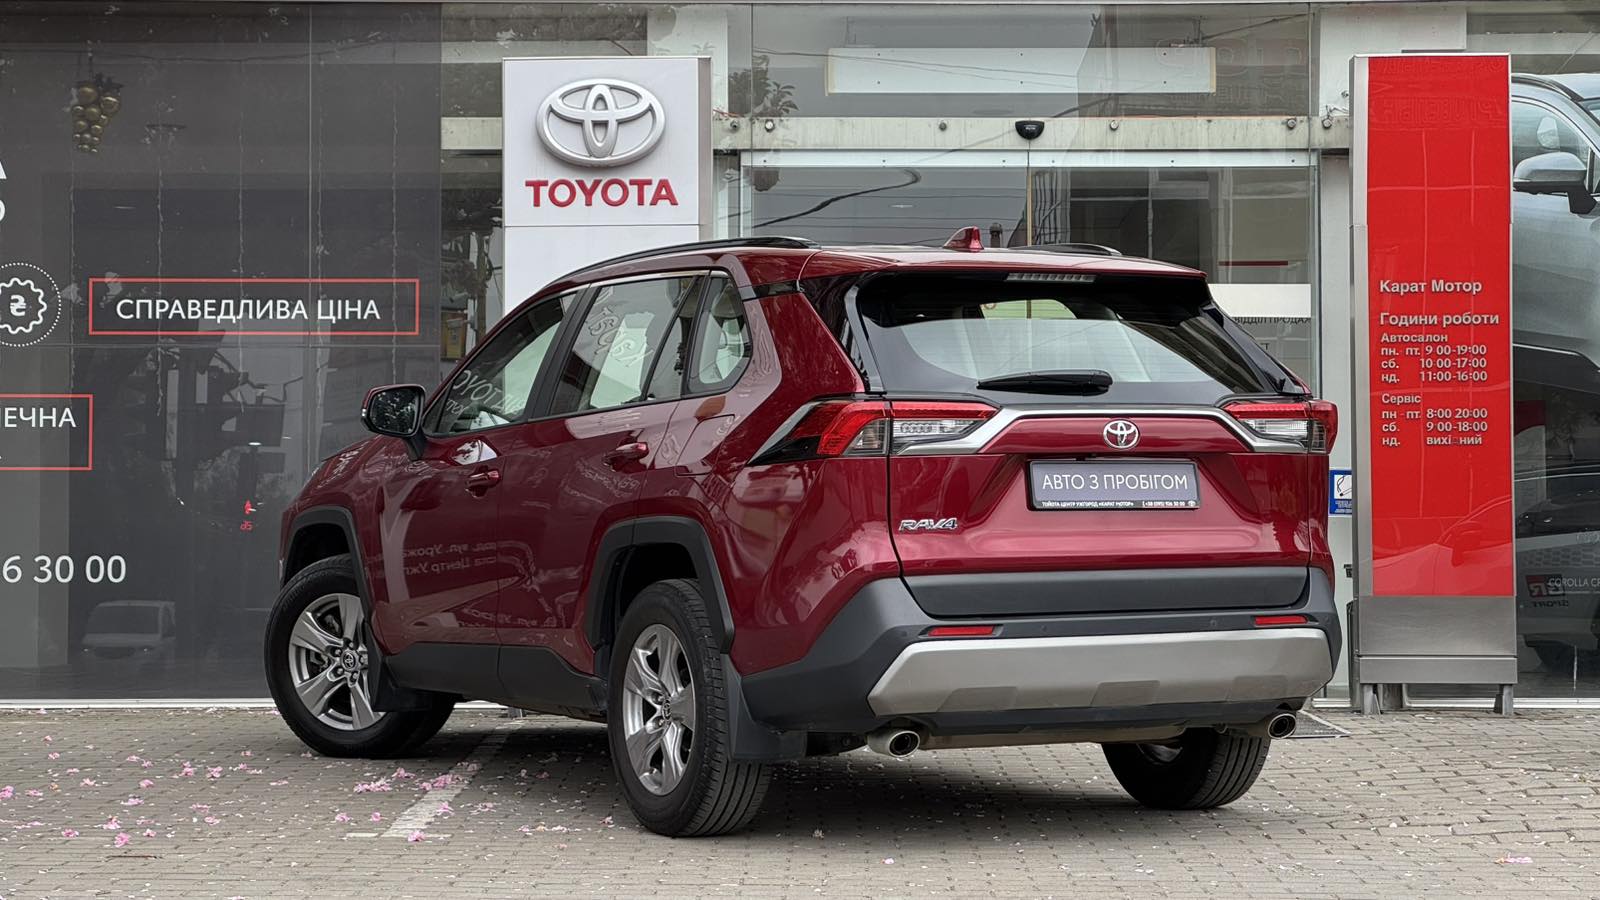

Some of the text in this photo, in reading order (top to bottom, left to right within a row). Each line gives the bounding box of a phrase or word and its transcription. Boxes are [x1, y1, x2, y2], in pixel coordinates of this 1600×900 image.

[525, 178, 679, 208] TOYOTA
[1379, 279, 1482, 296] Карат Мотор
[115, 299, 381, 324] СПРАВЕДЛИВА ЦІНА
[1380, 311, 1499, 328] Години роботи
[1380, 332, 1448, 343] Автосалон
[1381, 358, 1399, 368] сб.
[1381, 393, 1421, 405] Сервіс
[0, 407, 77, 428] ЕЧНА
[1042, 474, 1085, 490] АВТО
[1103, 474, 1188, 490] ПРОБІГОМ
[898, 518, 958, 532] RAV4
[33, 554, 75, 584] 30
[85, 554, 127, 584] 00
